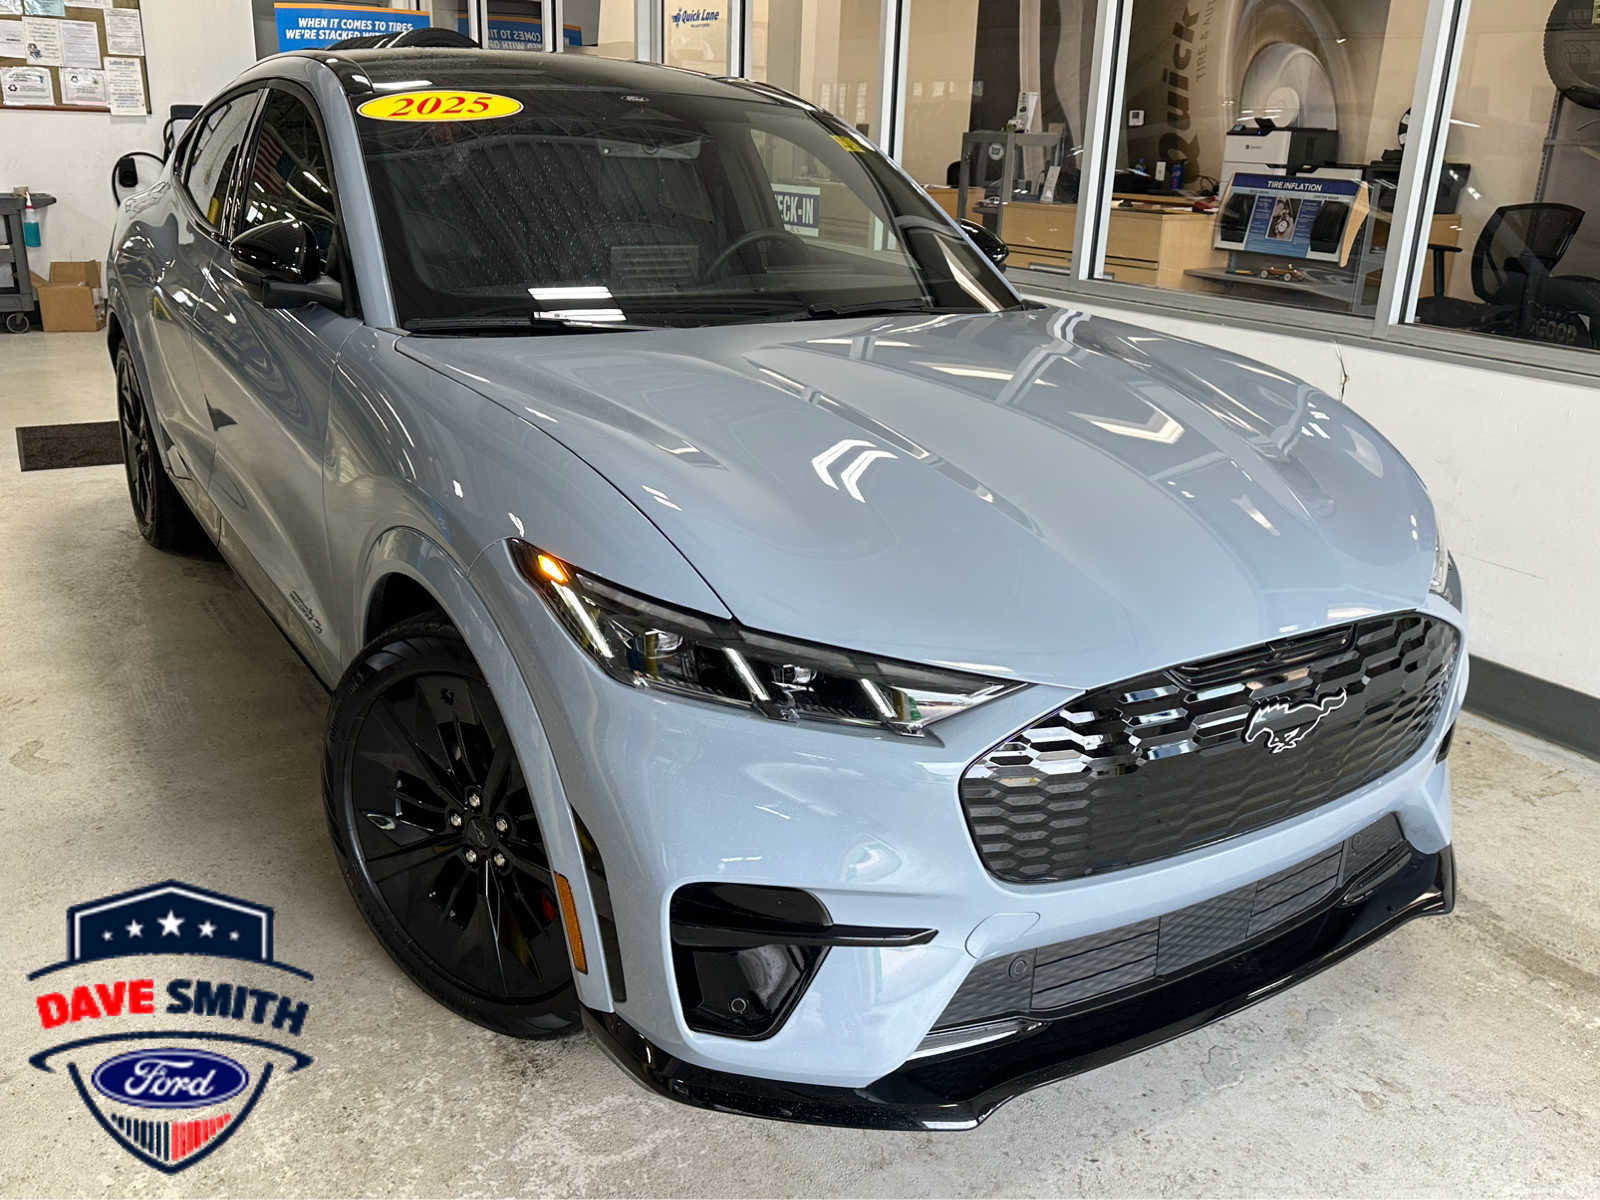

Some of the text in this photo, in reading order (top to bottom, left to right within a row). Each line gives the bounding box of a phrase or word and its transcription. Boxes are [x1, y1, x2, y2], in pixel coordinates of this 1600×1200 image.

[701, 9, 719, 21] Lane
[298, 17, 413, 33] WHEN IT COMES TO TIRES
[286, 29, 317, 40] WE'RE
[388, 96, 492, 117] 2025
[1267, 180, 1323, 192] TIRE INFLATION
[775, 193, 814, 225] ECK-IN
